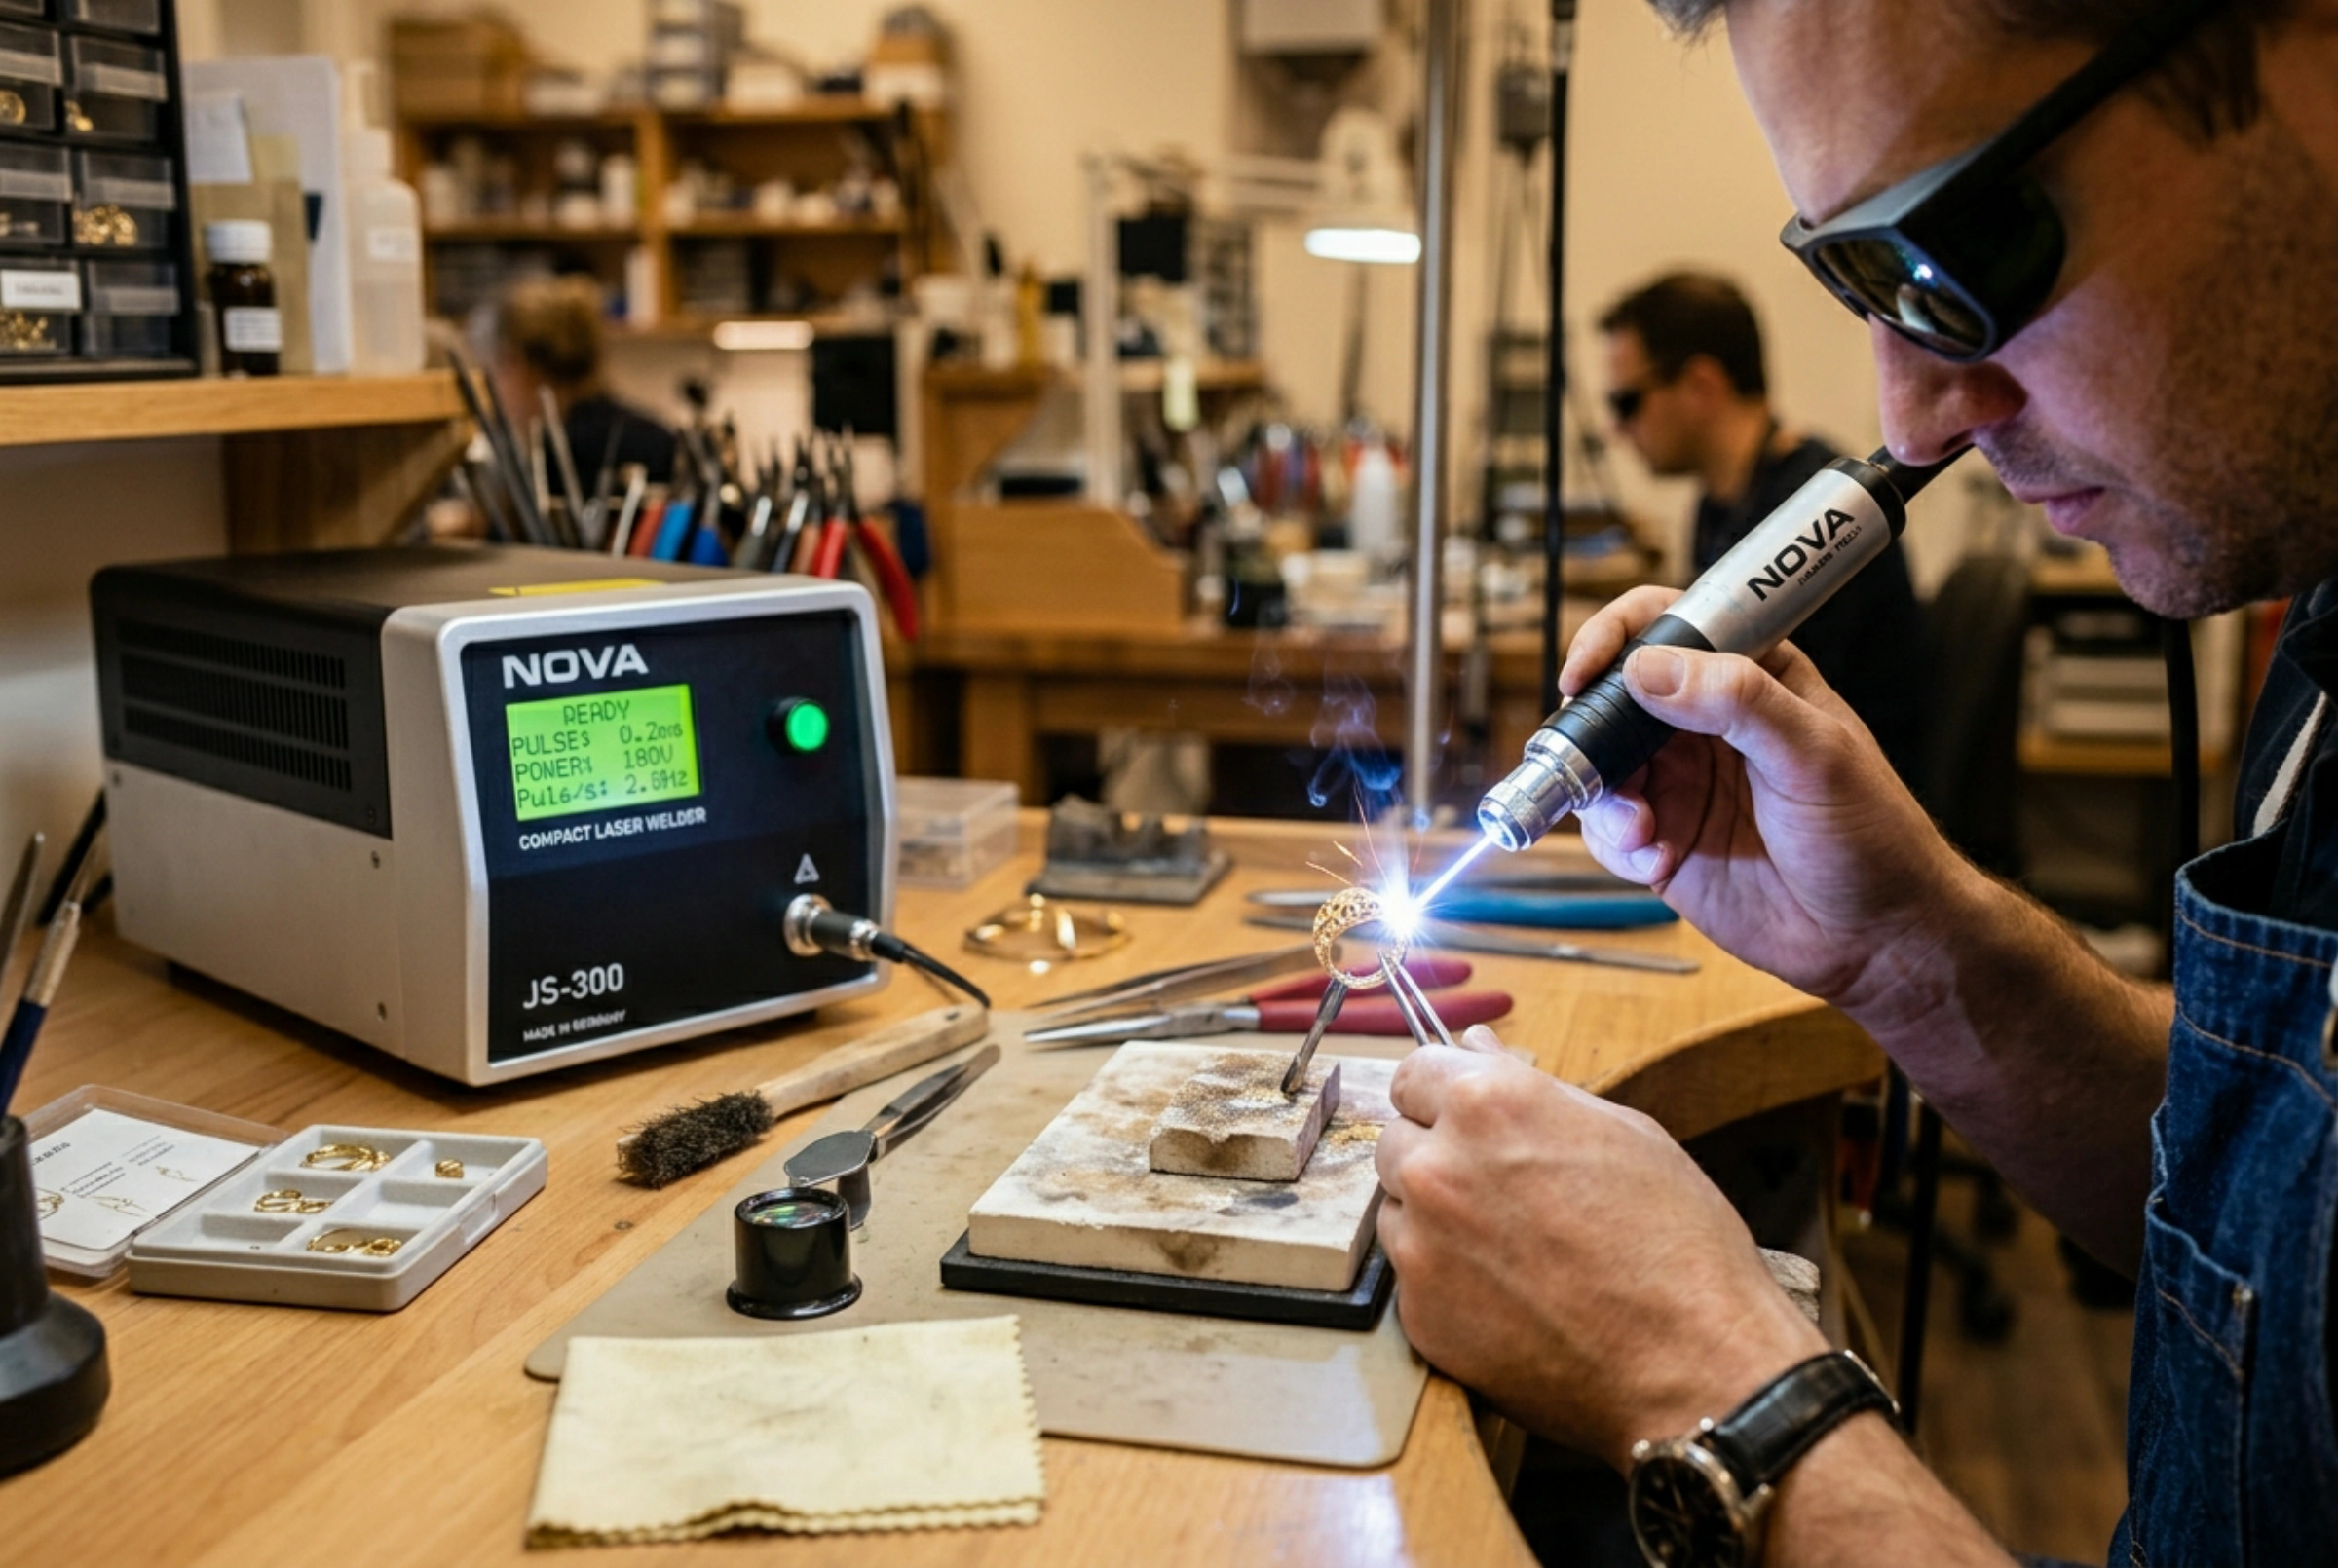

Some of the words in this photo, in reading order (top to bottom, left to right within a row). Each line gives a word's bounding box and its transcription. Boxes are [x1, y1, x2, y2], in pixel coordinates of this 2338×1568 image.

[1747, 507, 1855, 602] NOVA
[502, 643, 650, 689] NOVA
[562, 699, 631, 726] READY
[518, 824, 591, 850] COMPACT
[594, 815, 643, 840] LASER
[522, 962, 624, 1009] JS-300
